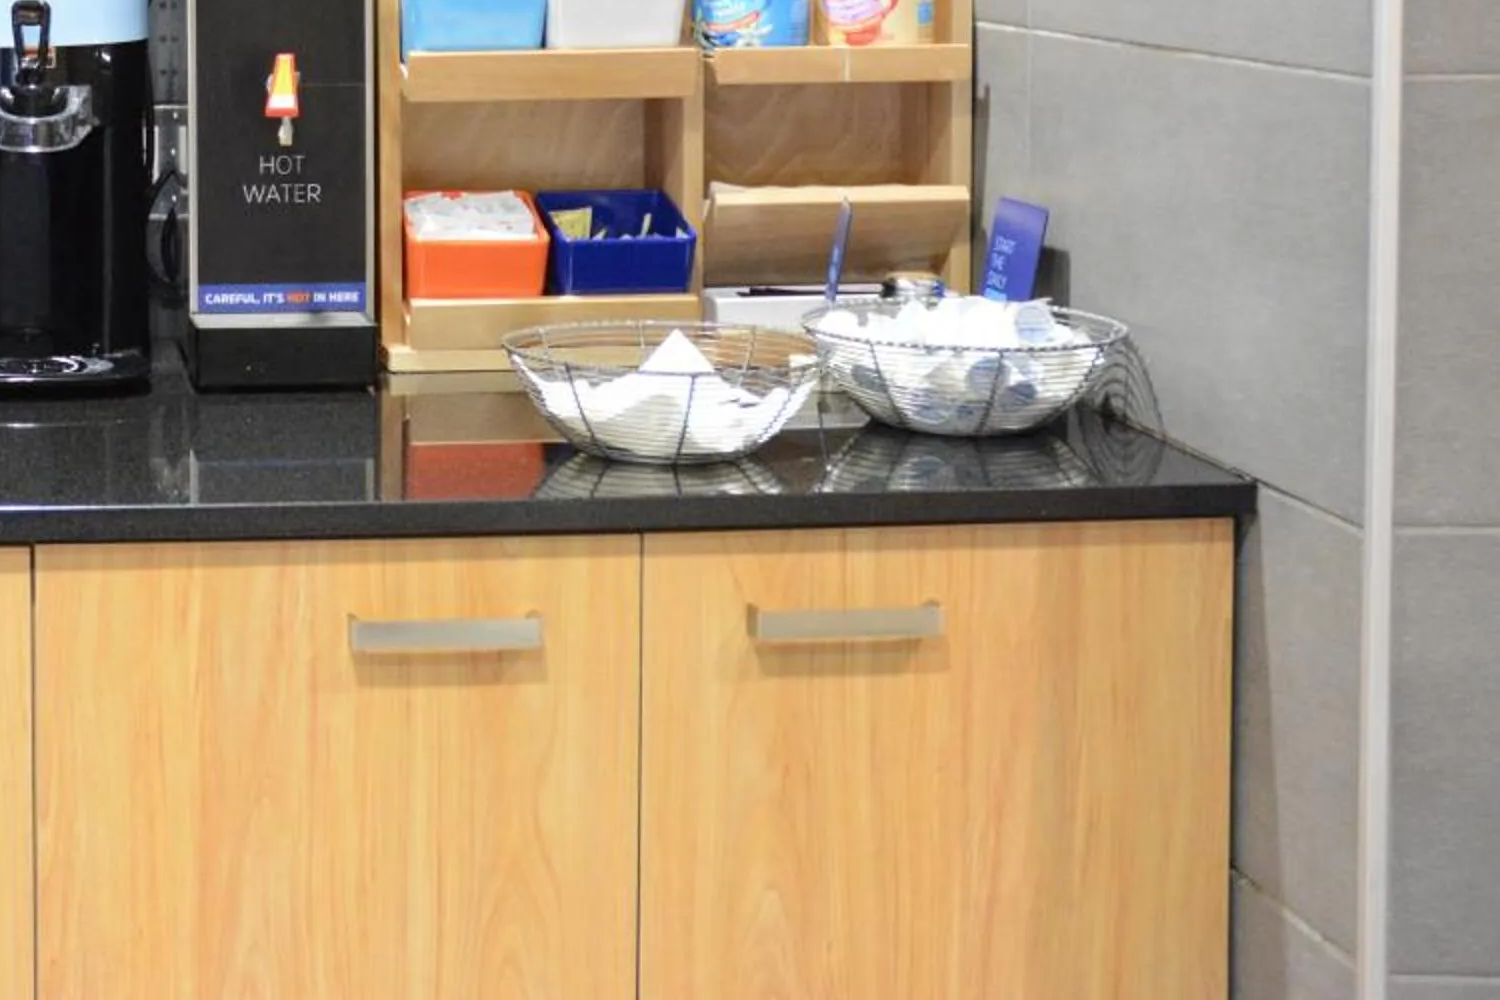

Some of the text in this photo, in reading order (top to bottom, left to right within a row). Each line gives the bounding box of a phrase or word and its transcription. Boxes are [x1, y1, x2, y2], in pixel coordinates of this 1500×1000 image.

[258, 154, 306, 175] HOT
[243, 183, 322, 203] WATER
[205, 293, 261, 305] CAREFUL,
[263, 292, 285, 304] IT'S
[313, 291, 327, 303] IN
[329, 291, 360, 303] HERE
